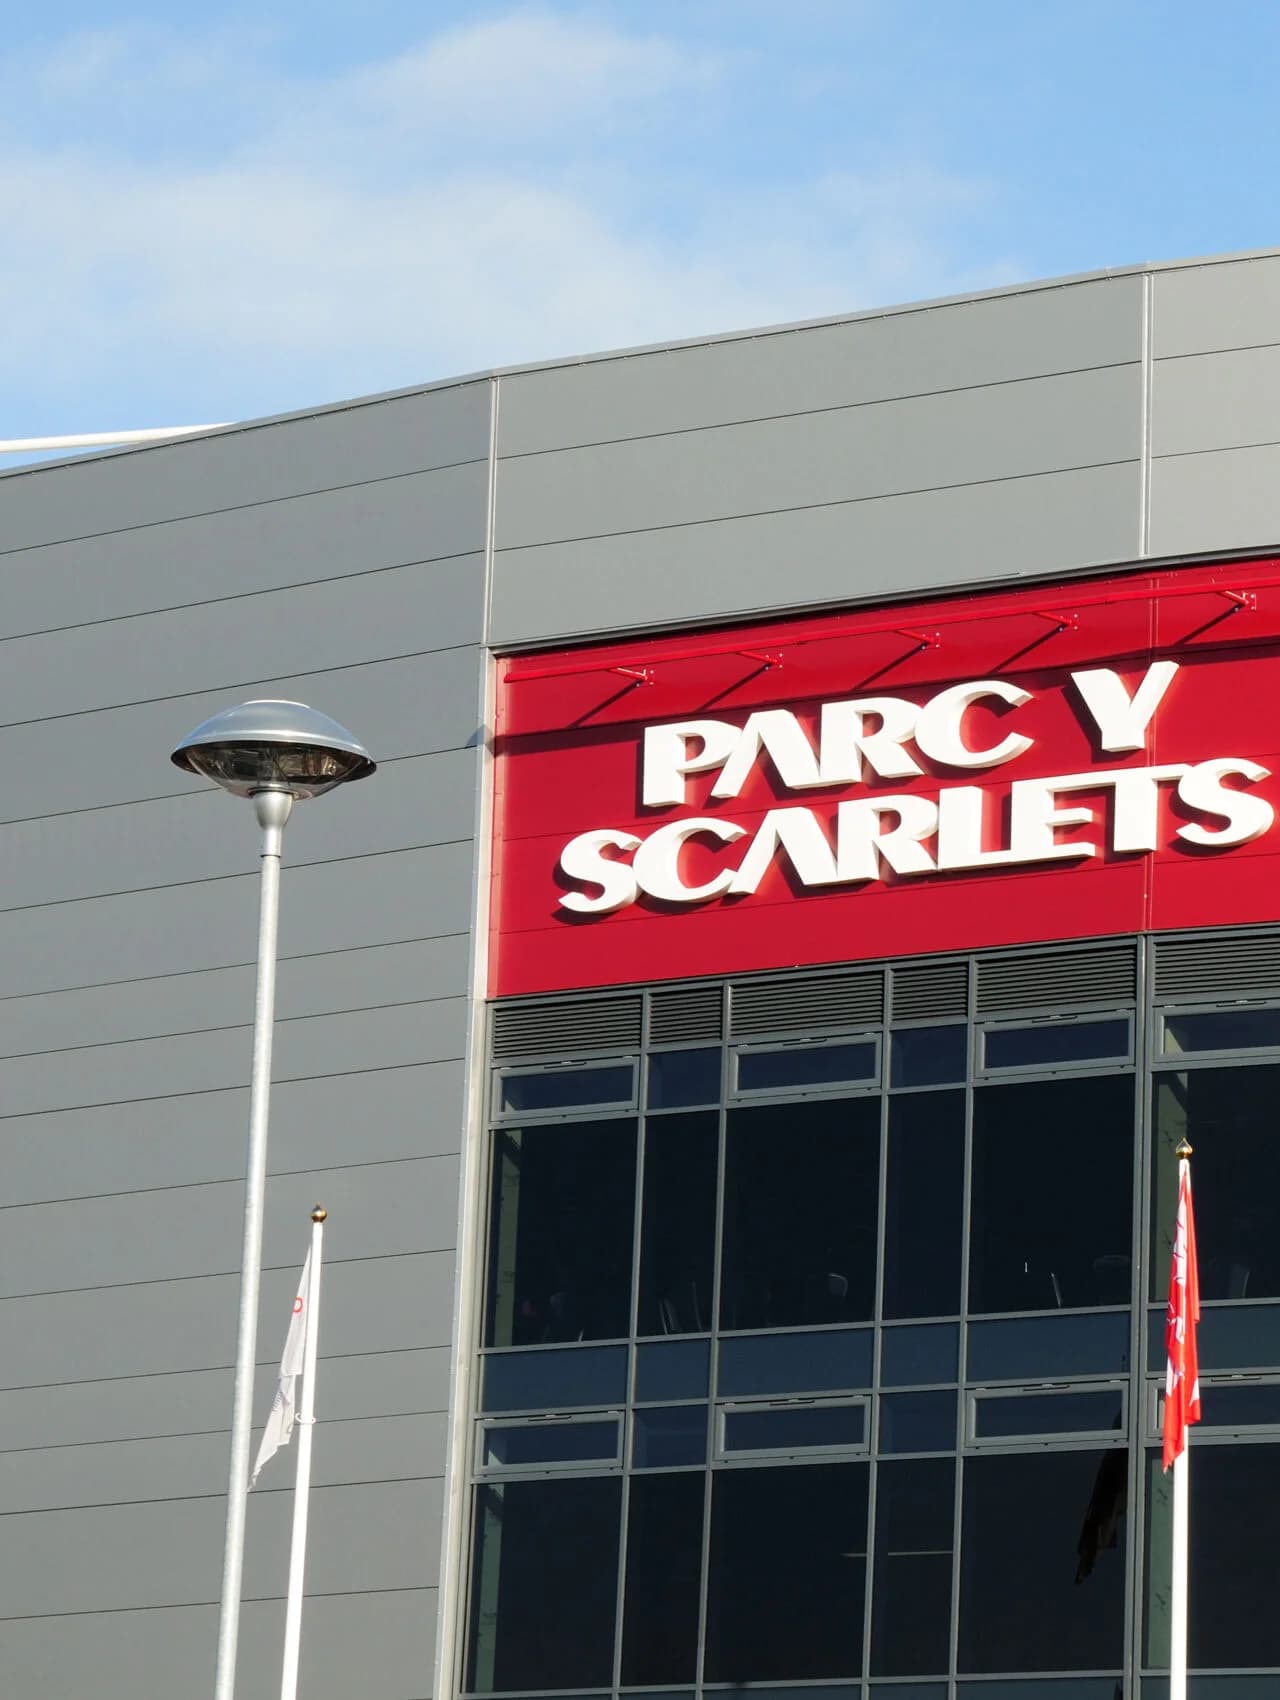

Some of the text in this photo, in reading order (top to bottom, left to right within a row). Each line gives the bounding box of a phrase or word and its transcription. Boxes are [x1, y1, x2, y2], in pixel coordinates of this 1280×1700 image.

[642, 660, 1180, 807] PARC Y
[558, 757, 1275, 914] SCARLETS
